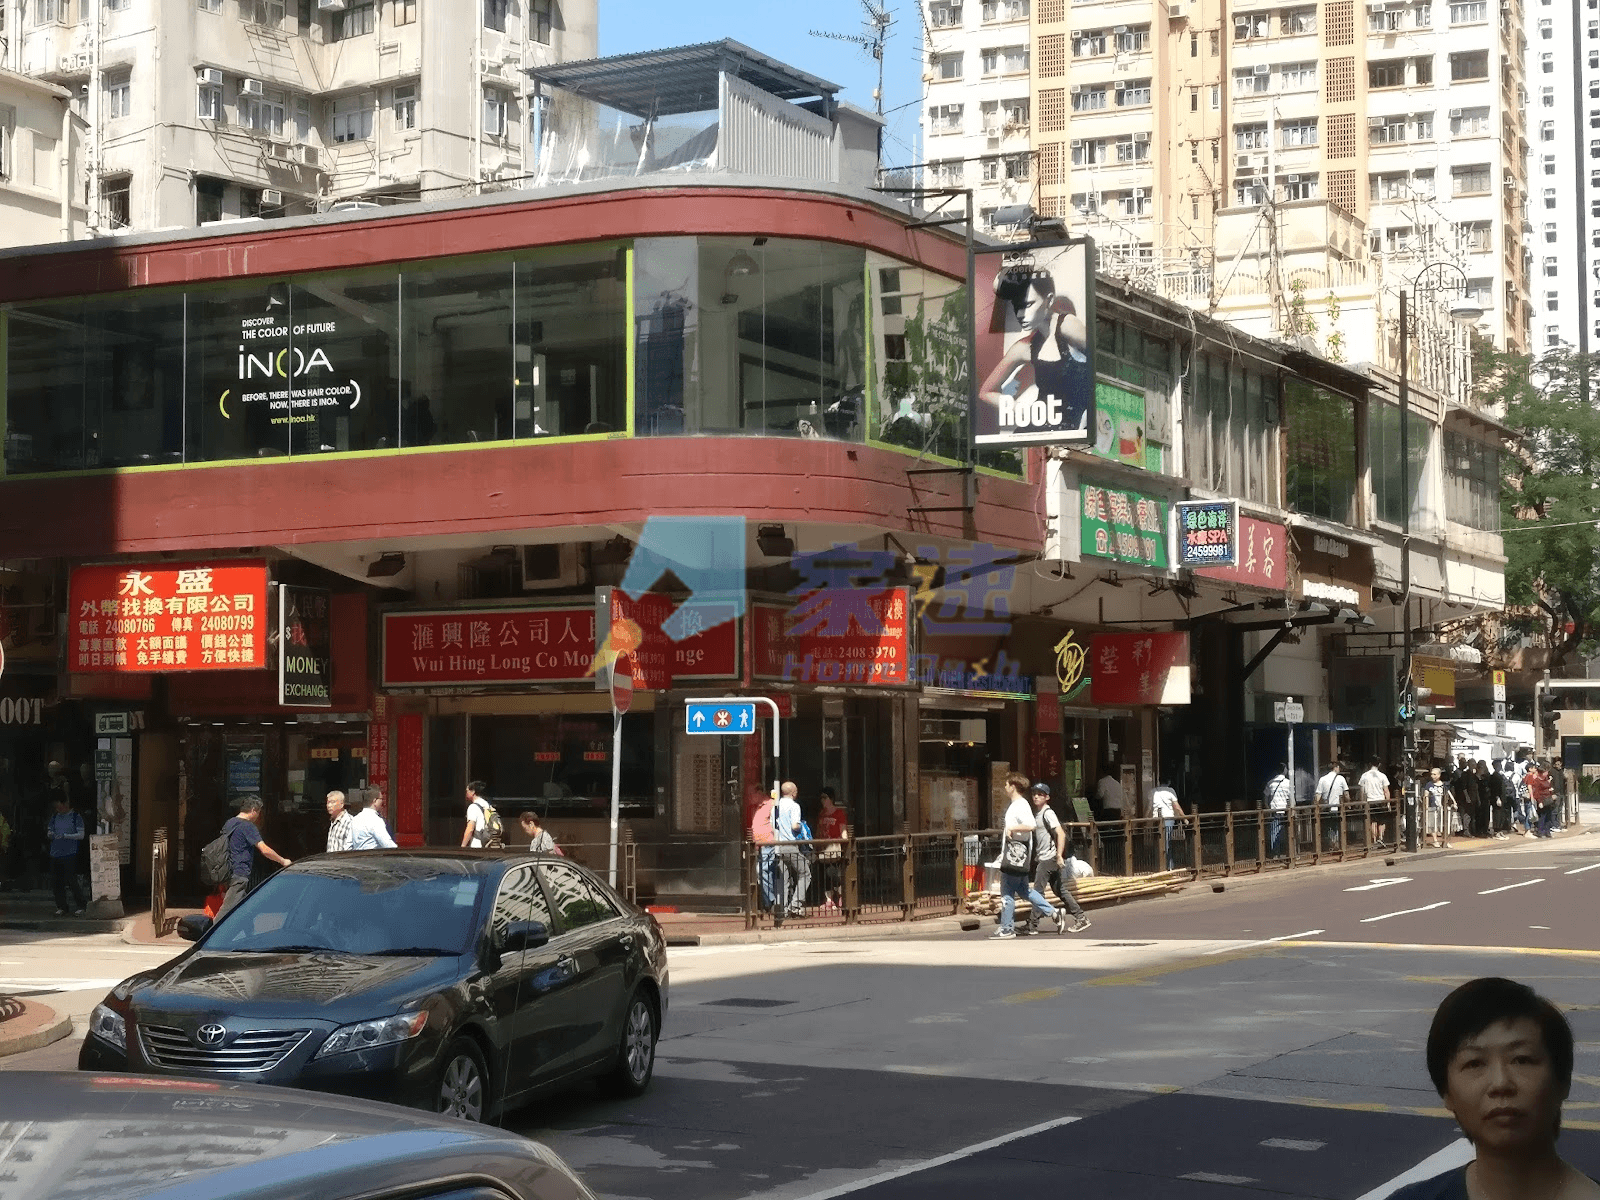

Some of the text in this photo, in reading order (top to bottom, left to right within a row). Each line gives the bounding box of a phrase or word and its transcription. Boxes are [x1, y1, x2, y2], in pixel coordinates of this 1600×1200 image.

[242, 317, 274, 327] DISCOVER
[242, 322, 336, 340] THE COLOR OF FUTURE
[242, 386, 352, 402] BEFORE, THERE WAS HAIR COLOR.
[270, 398, 339, 410] NOW, THERE IS INOA.
[999, 394, 1062, 428] Root
[1187, 544, 1228, 557] 24599981
[118, 569, 214, 596] 永盛
[80, 594, 254, 617] 外幣找換有限公司
[79, 615, 254, 635] 電話 24080766 傳真 24080799
[839, 647, 866, 659] 2408
[868, 646, 896, 659] 3970
[286, 655, 329, 674] MONEY
[413, 651, 598, 674] Wui Hing Long Co Mon
[868, 662, 896, 675] 3972
[285, 684, 329, 698] EXCHANGE
